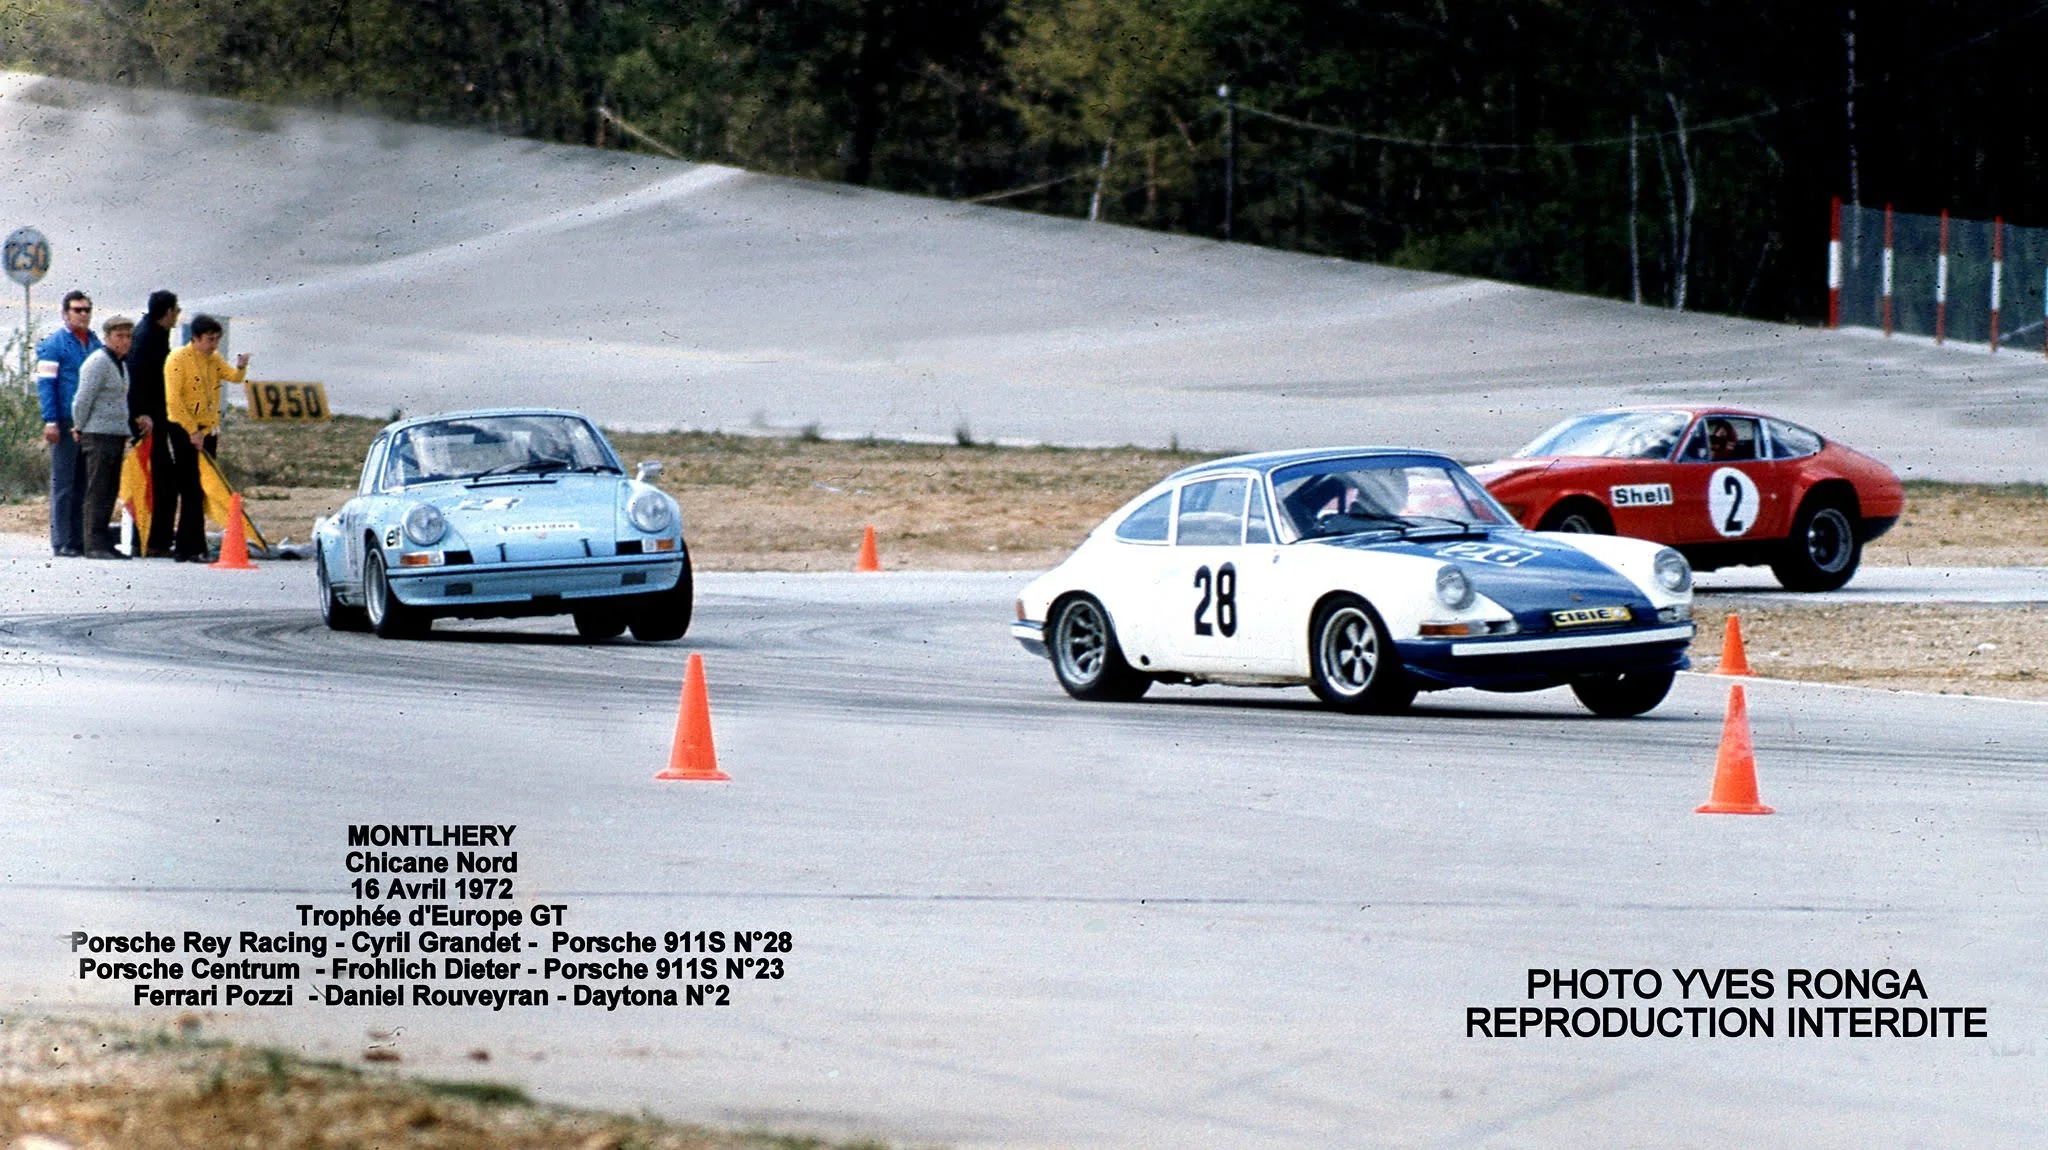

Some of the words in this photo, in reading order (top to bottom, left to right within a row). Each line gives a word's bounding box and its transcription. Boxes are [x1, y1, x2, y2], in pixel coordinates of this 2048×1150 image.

[251, 384, 322, 417] 1250
[1614, 486, 1671, 504] Shell
[1724, 475, 1743, 532] 2
[1193, 561, 1238, 638] 28
